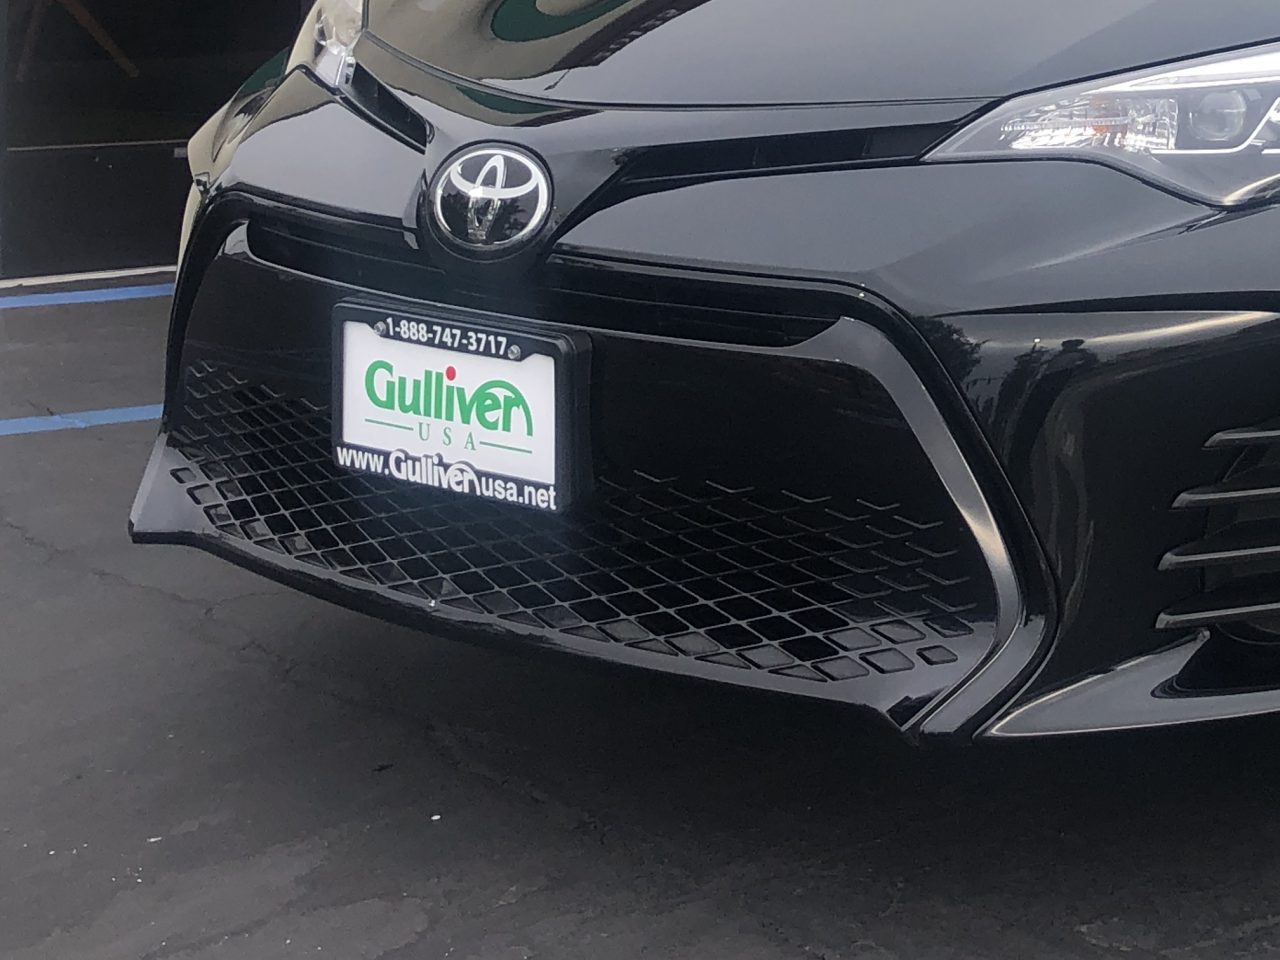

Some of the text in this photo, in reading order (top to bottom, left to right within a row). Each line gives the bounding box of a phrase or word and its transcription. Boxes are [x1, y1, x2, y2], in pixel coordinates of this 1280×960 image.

[385, 316, 508, 357] 1-888-747-3717
[364, 359, 534, 437] Gulliver
[336, 445, 557, 511] www.Gulliverusa.net
